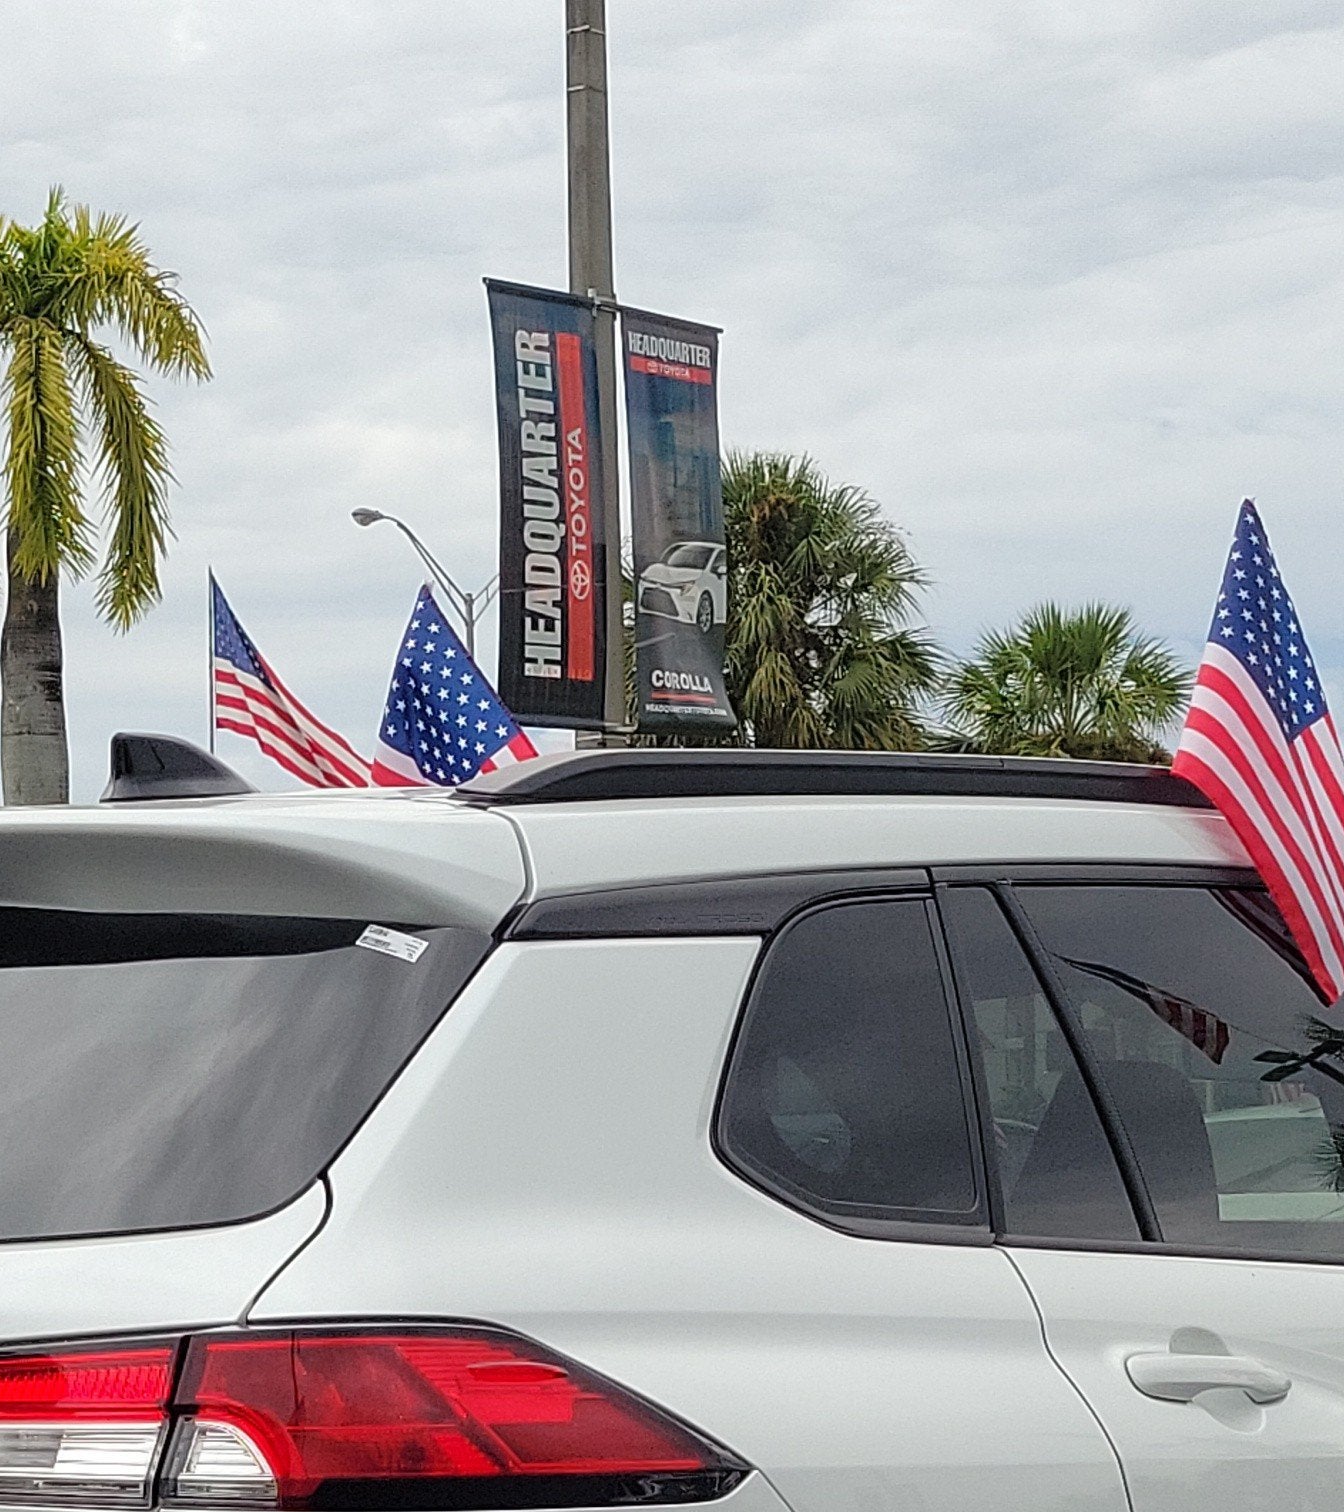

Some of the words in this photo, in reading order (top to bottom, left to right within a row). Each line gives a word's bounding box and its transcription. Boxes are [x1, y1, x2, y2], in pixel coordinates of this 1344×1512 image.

[628, 331, 711, 368] HEADQUARTER
[515, 329, 563, 679] HEADQUARTER
[567, 427, 591, 552] TOYOTA
[651, 669, 713, 694] COROLLA
